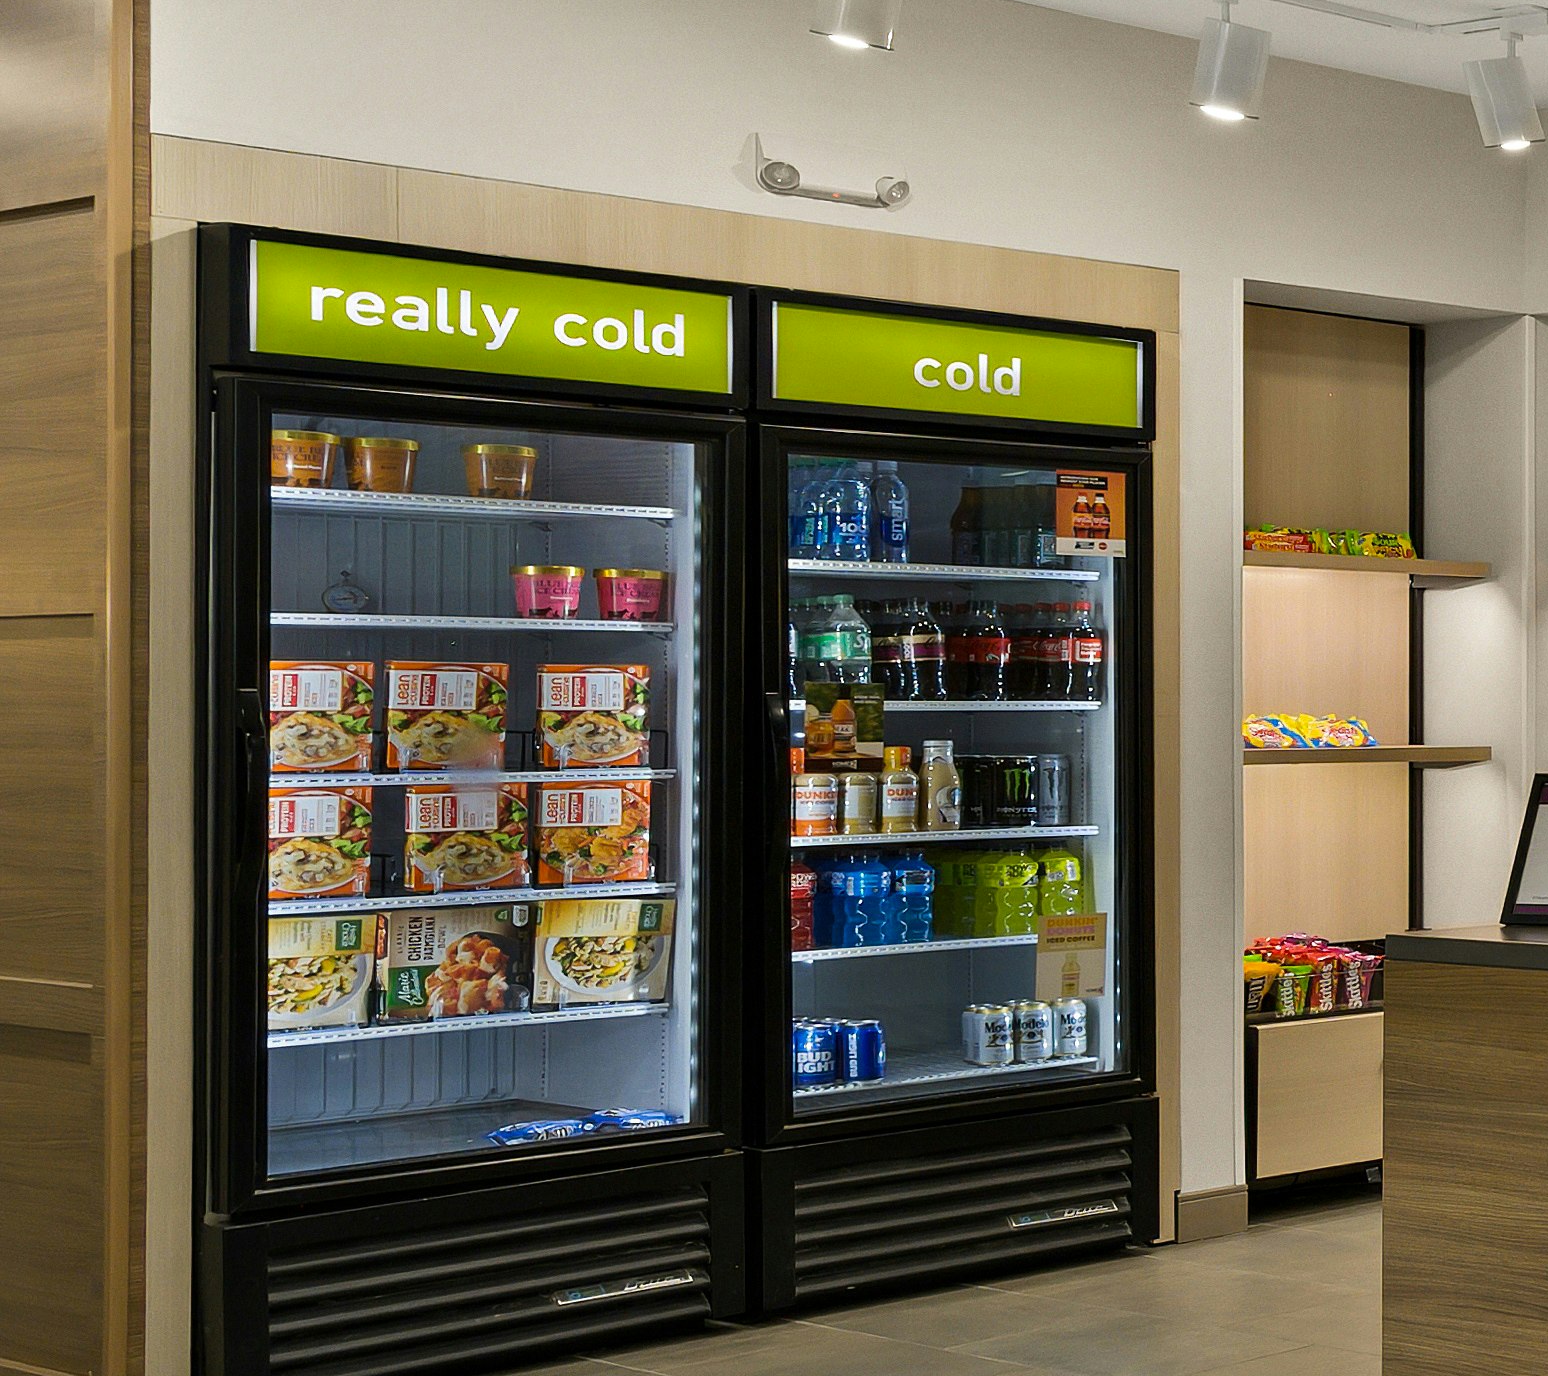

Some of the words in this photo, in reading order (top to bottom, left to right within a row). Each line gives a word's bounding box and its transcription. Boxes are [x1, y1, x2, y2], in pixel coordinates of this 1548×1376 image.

[310, 285, 520, 351] really
[553, 308, 686, 357] cold
[913, 352, 1021, 397] cold
[397, 674, 411, 705] Lean
[550, 677, 562, 706] Lean
[419, 797, 431, 829] Lean
[546, 793, 559, 824] Lean
[408, 916, 423, 961] CHICKEN
[1319, 963, 1334, 1012] Skittles
[1345, 961, 1363, 1009] Skittles
[797, 1051, 832, 1063] BUD
[797, 1060, 835, 1073] IGHT
[849, 1059, 858, 1078] BUD
